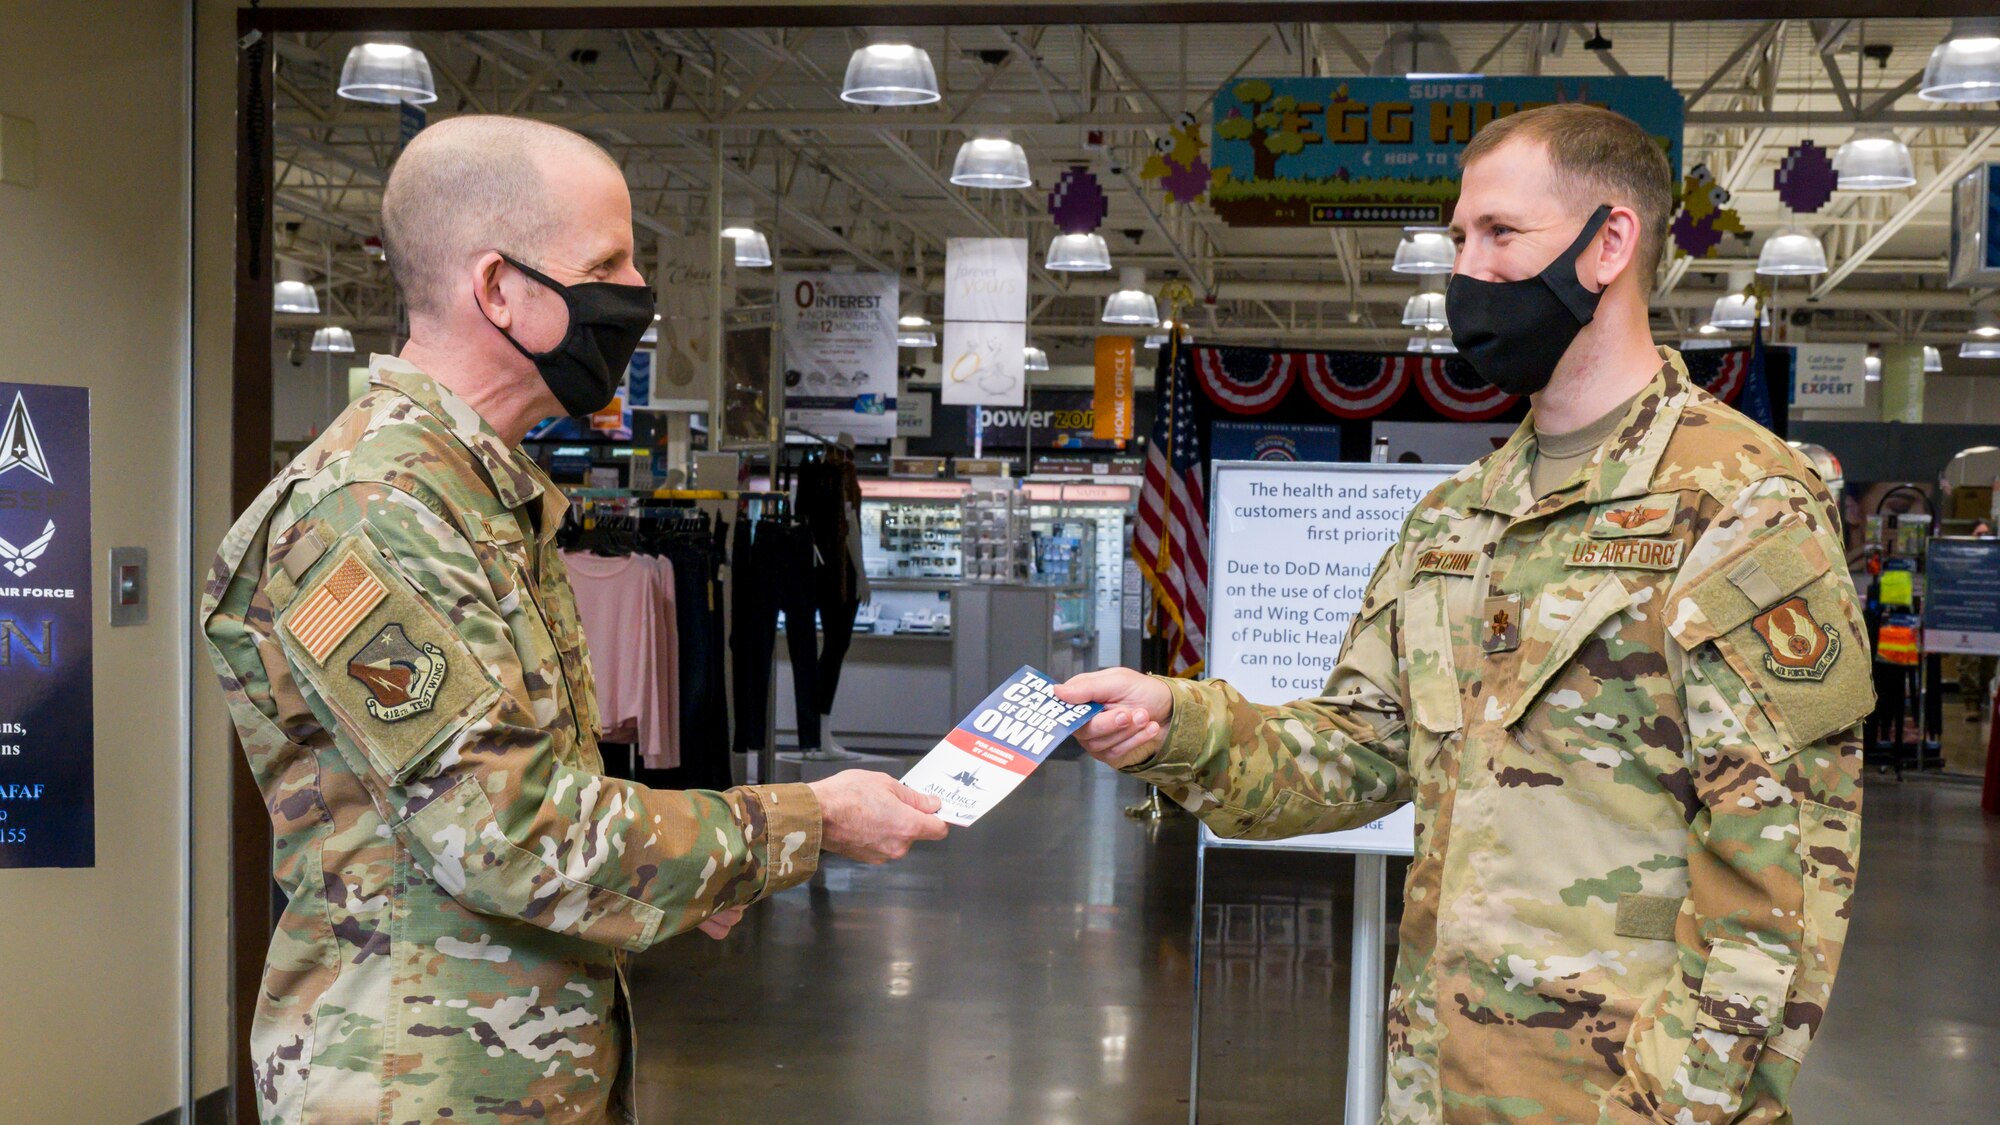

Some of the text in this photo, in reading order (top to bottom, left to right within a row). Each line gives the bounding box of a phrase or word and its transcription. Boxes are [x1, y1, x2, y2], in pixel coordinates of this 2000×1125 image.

[1409, 84, 1485, 100] SUPER
[1283, 101, 1413, 144] EGG
[1384, 152, 1419, 165] HOP
[1426, 153, 1448, 165] TO
[954, 262, 997, 281] forever
[962, 278, 1017, 299] yours
[815, 295, 882, 309] INTEREST
[825, 310, 881, 320] PAYMENTS
[797, 320, 881, 333] FOR 12 MONTHS
[1801, 382, 1853, 394] EXPERT
[1114, 358, 1126, 438] HOME OFFICE
[1250, 482, 1278, 497] The
[1283, 483, 1333, 498] health
[1338, 484, 1368, 499] and
[1372, 484, 1422, 503] safety
[1234, 505, 1317, 519] customers
[1322, 505, 1351, 520] and
[1307, 525, 1340, 541] first
[1572, 543, 1598, 563] U.S.
[1599, 541, 1627, 563] AIR
[1227, 560, 1259, 574] Due
[1264, 561, 1280, 575] to
[1285, 562, 1320, 576] DoD
[23, 588, 75, 598] FORCE
[1226, 585, 1246, 597] on
[1251, 583, 1276, 598] the
[1281, 586, 1308, 599] use
[1312, 584, 1330, 599] of
[1234, 606, 1263, 620] and
[1268, 606, 1309, 625] Wing
[1231, 627, 1345, 645] of Public Heal
[1240, 654, 1268, 665] can
[1272, 655, 1293, 666] no
[1271, 675, 1288, 689] to
[384, 663, 444, 719] 412TH TEST WING
[1003, 683, 1084, 727] CARE
[998, 701, 1059, 733] OF OUR
[973, 709, 1056, 756] OWN
